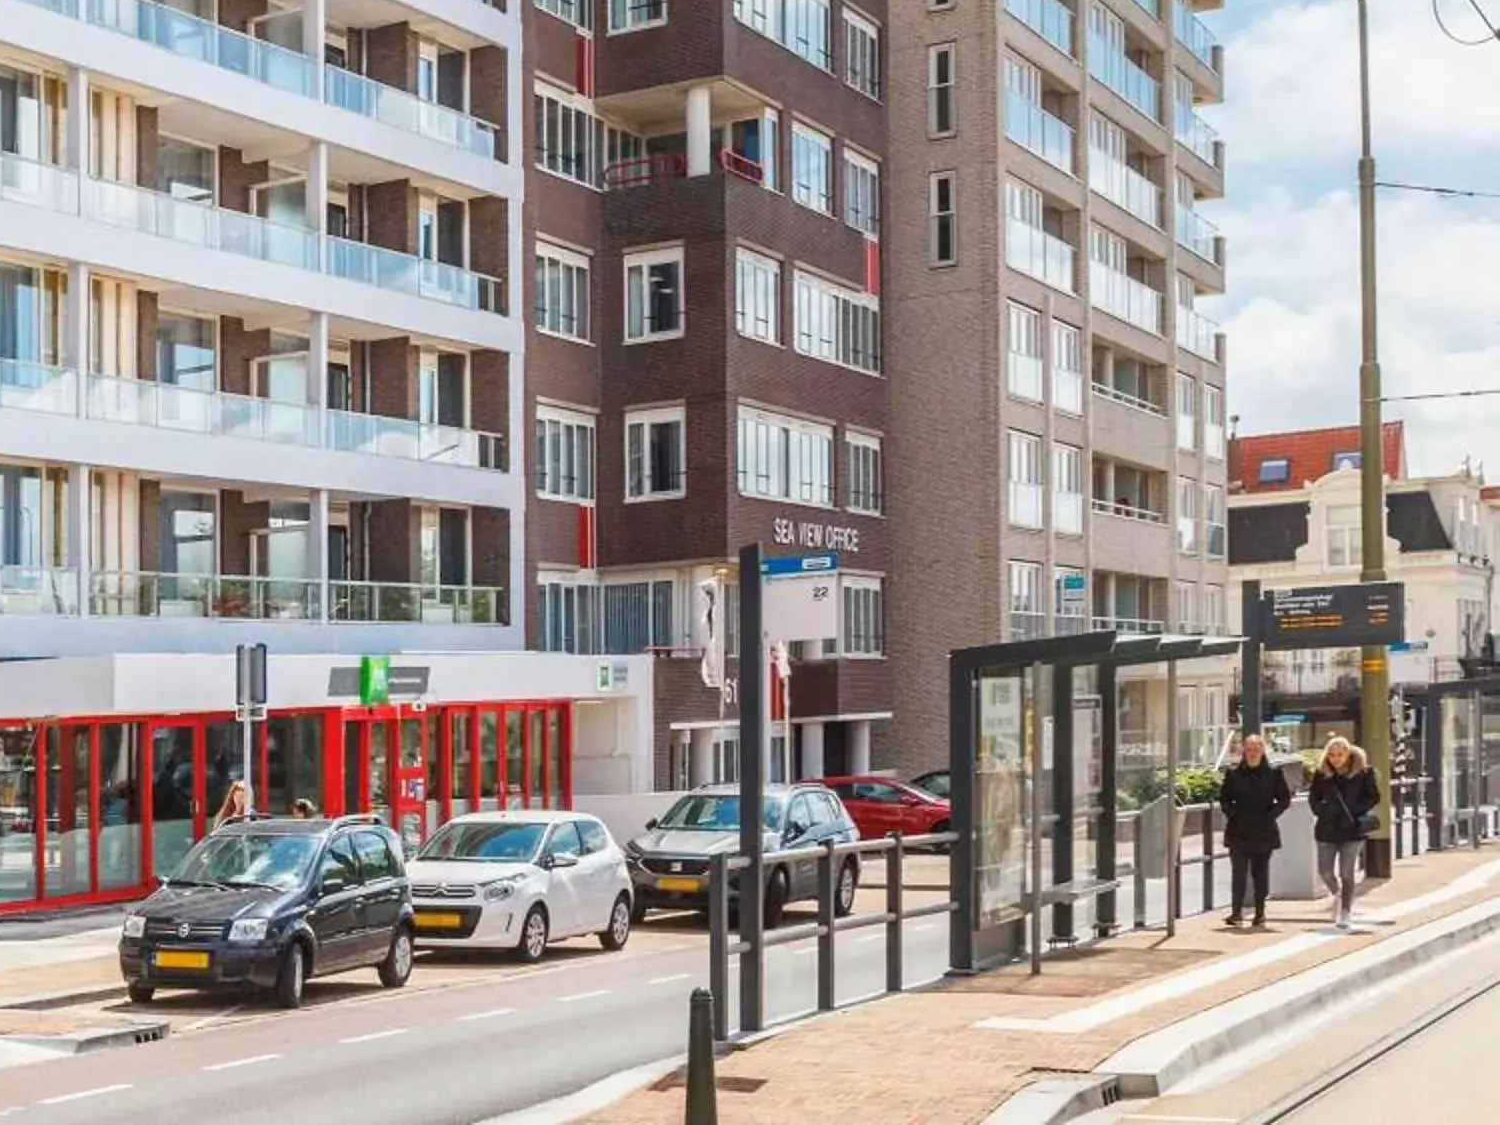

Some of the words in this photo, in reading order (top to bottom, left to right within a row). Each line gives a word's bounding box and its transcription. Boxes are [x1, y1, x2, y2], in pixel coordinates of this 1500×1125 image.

[773, 517, 795, 544] SEA
[798, 522, 824, 549] VIEW
[825, 525, 860, 552] OFFICE
